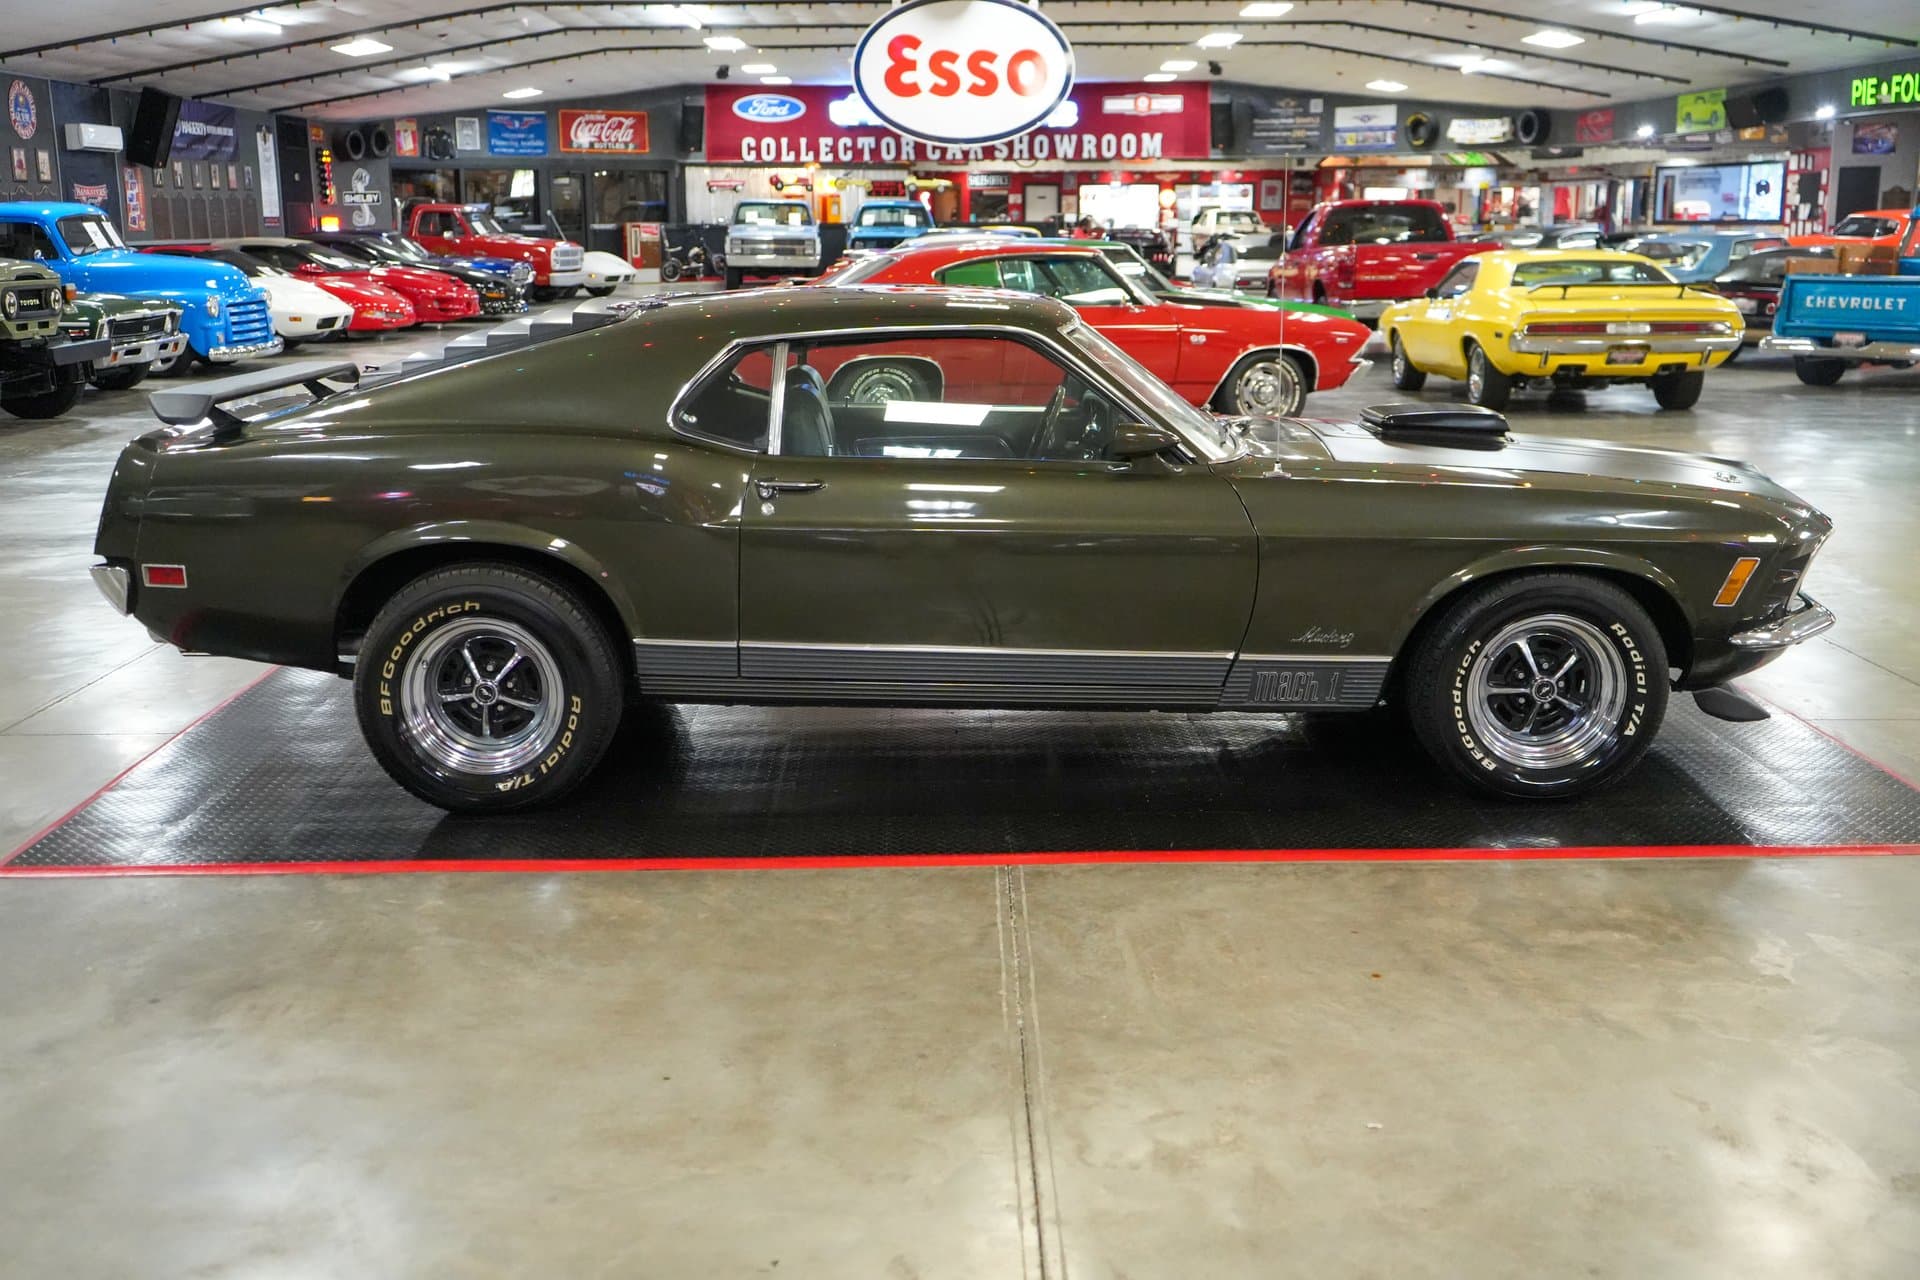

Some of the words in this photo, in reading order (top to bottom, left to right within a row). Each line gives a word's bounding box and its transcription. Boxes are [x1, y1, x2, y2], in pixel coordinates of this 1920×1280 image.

[1851, 77, 1878, 106] PIE
[747, 98, 790, 116] Ford
[570, 116, 636, 142] Coca-Cola
[741, 136, 916, 162] COLLECTOR
[994, 132, 1164, 160] SHOWROOM
[344, 194, 378, 203] SHELBY
[1806, 296, 1907, 311] CHEVROLET
[1290, 626, 1356, 648] Mustang
[380, 600, 480, 716] BFGoodrich
[1610, 623, 1648, 694] Radial
[1450, 639, 1498, 772] BFGoodrich
[1624, 703, 1645, 737] T/A
[541, 694, 582, 775] Radial
[495, 775, 536, 792] T/A
